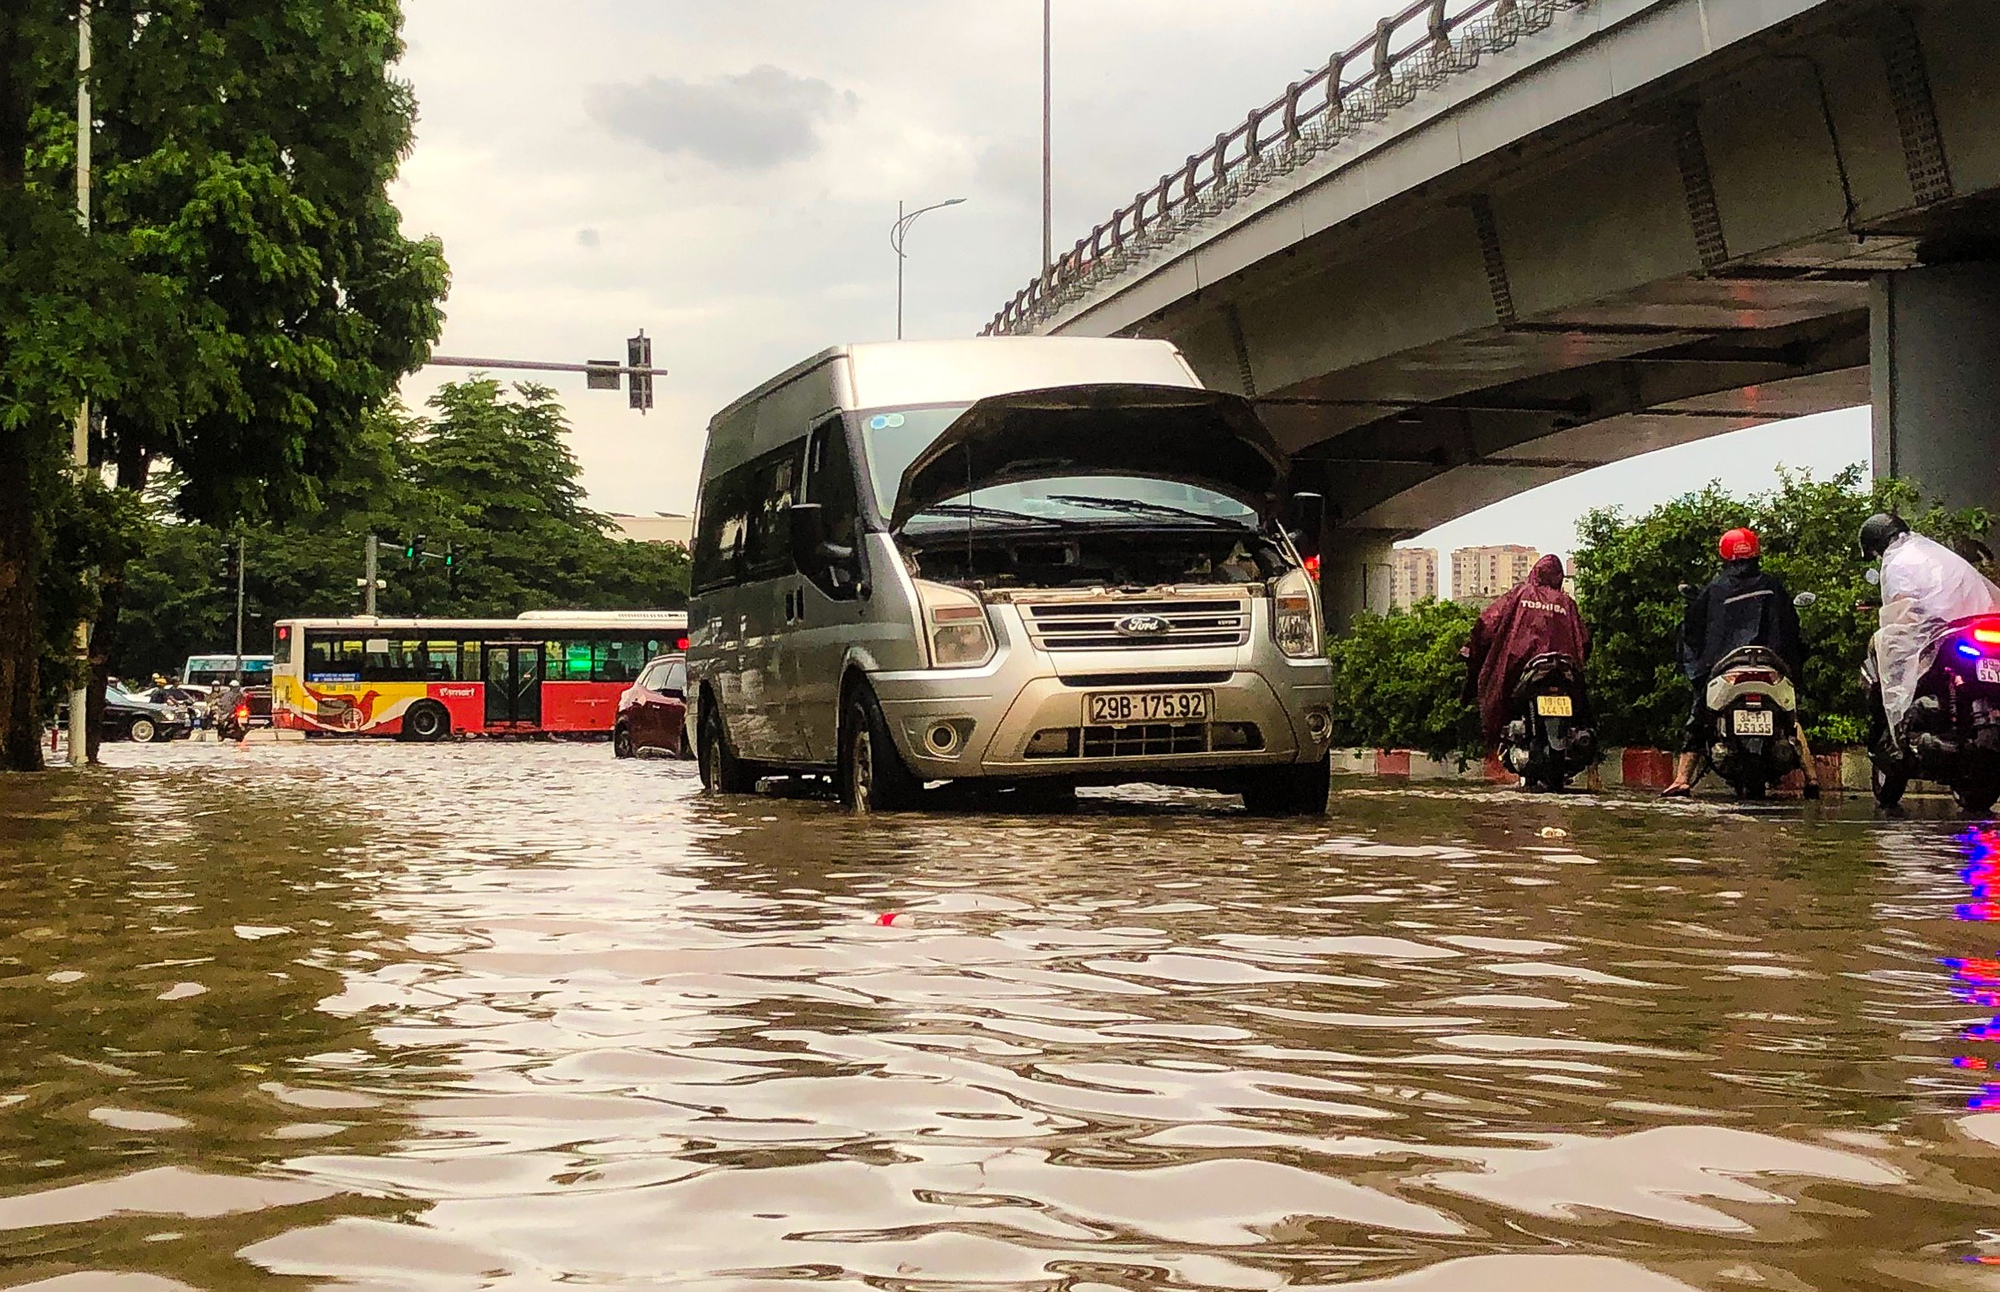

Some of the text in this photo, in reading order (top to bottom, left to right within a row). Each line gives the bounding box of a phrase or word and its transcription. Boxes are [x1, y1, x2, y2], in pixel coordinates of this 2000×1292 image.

[1521, 600, 1567, 616] TOSHIBA
[1128, 618, 1159, 631] Ford
[1094, 695, 1204, 719] 29B-175.92
